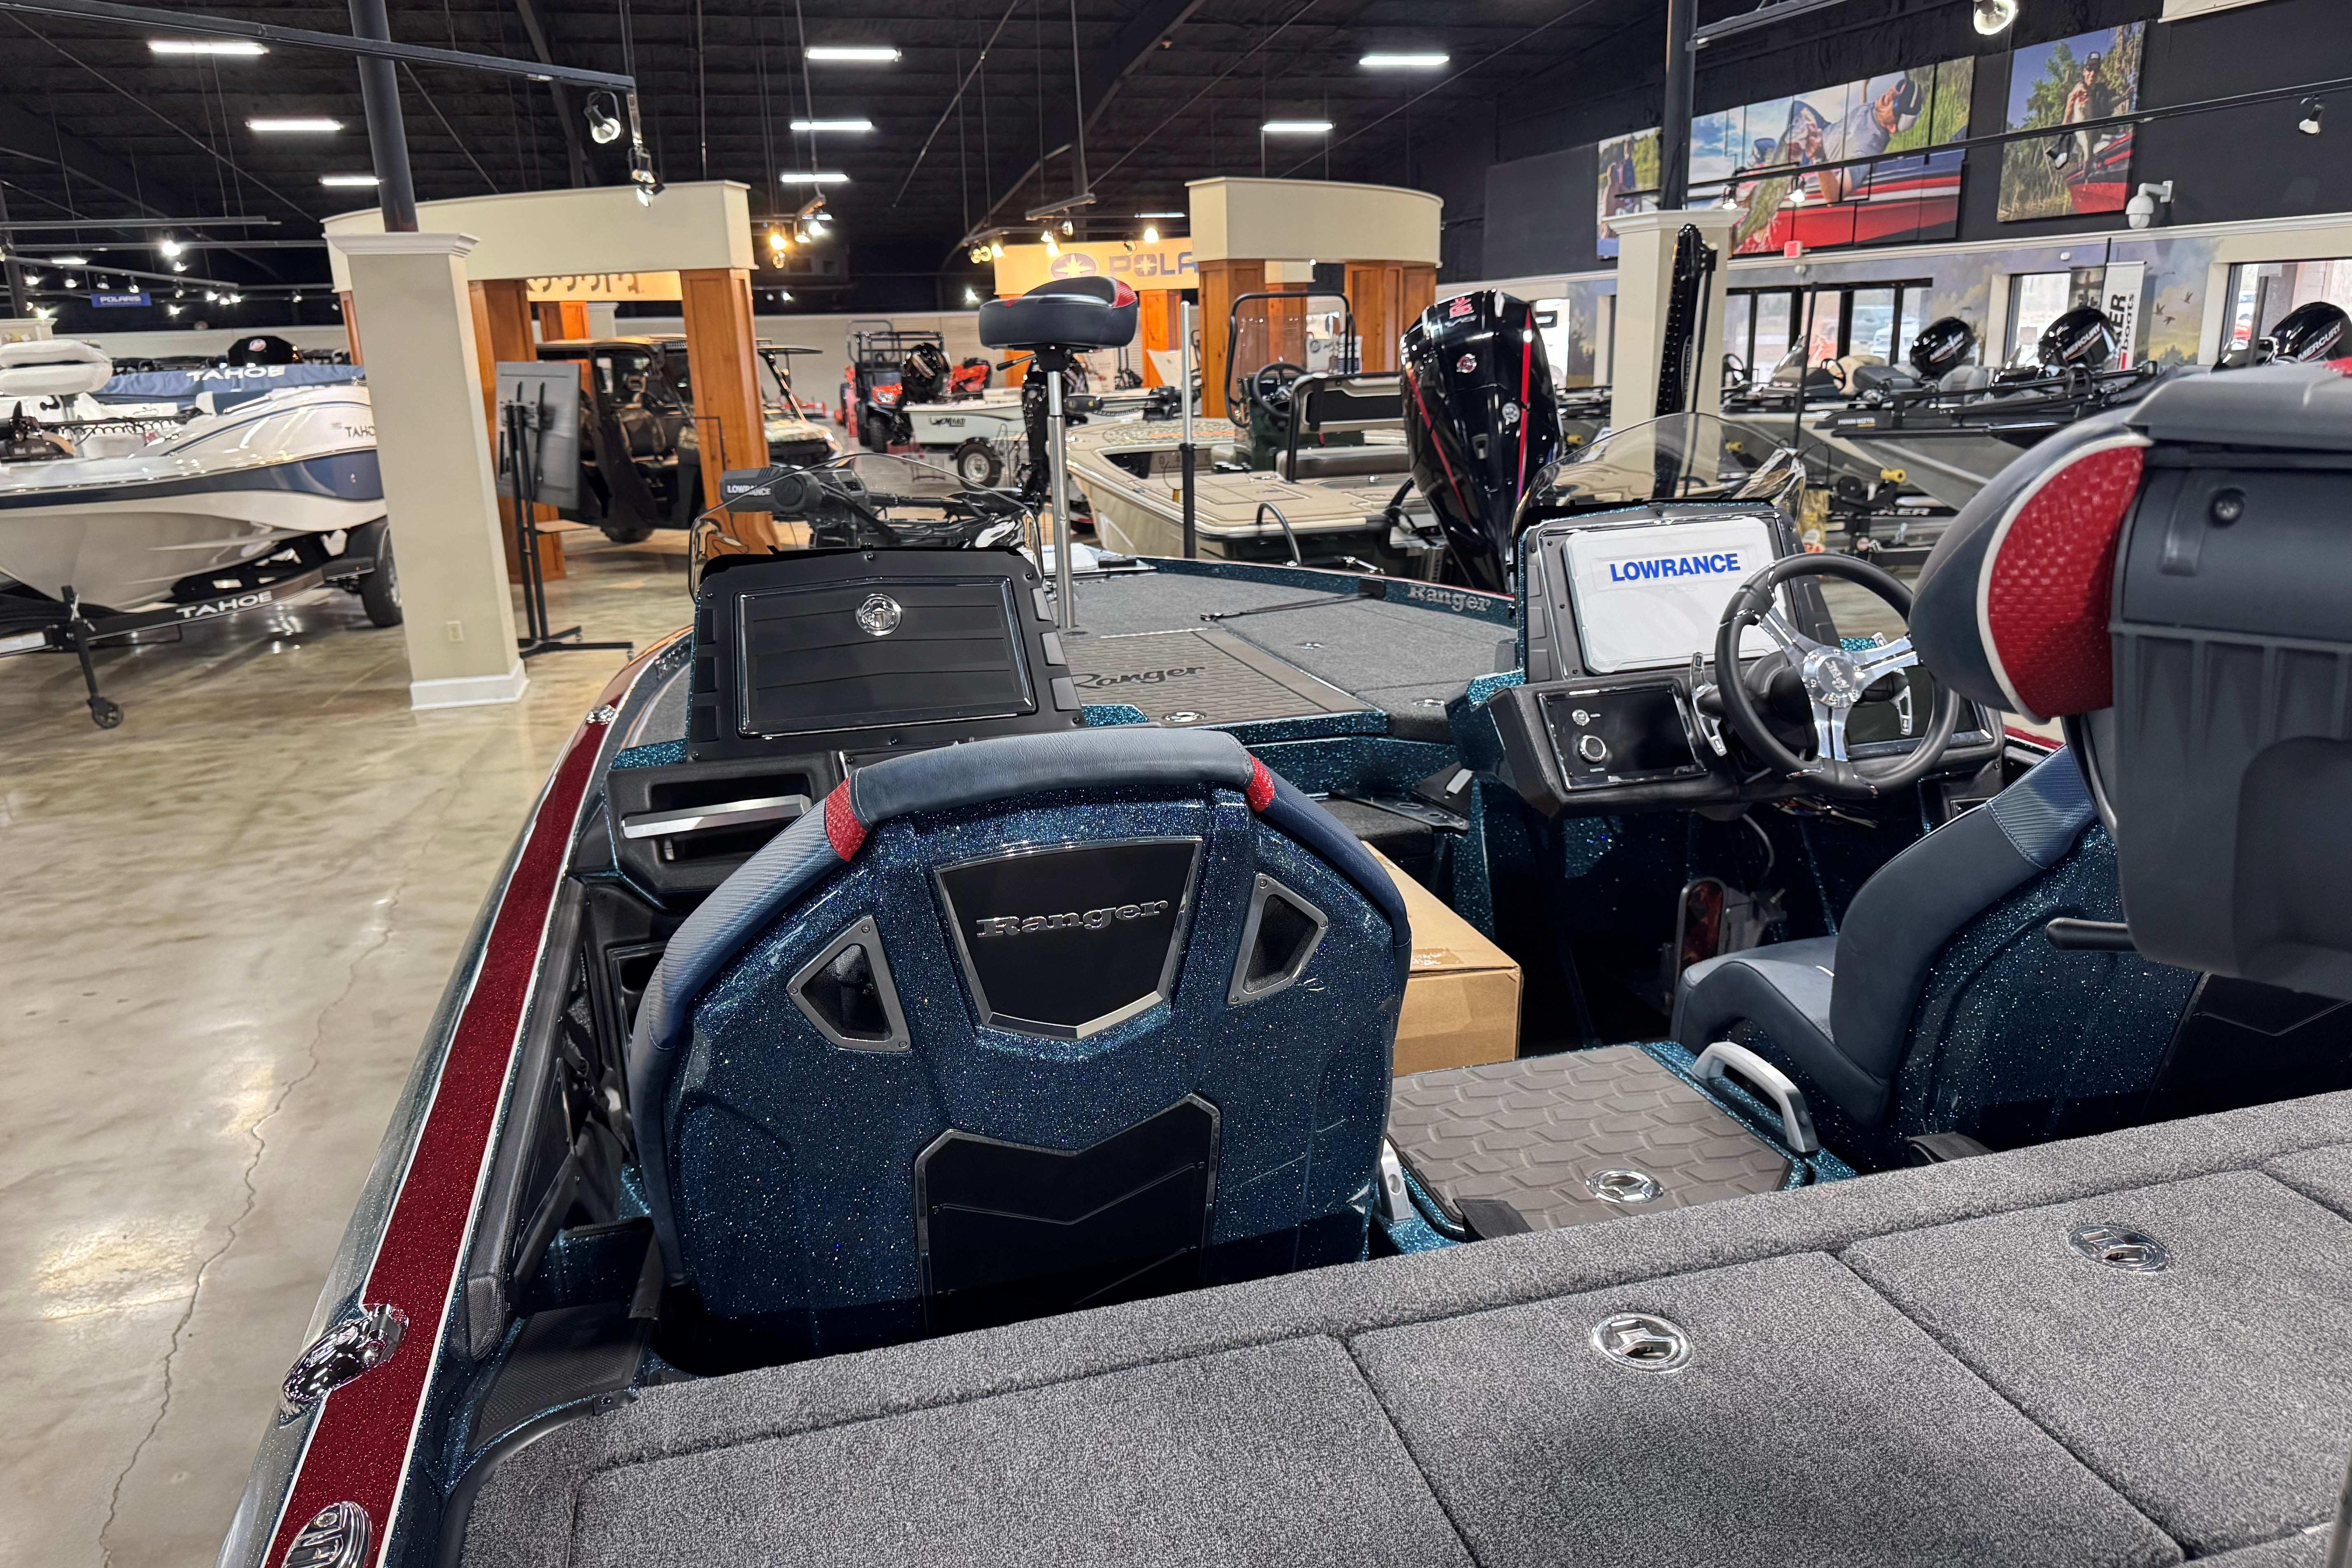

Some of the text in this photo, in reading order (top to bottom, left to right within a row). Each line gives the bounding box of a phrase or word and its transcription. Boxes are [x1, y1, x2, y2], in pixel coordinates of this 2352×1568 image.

[2063, 322, 2101, 360] MERCURY
[2298, 322, 2340, 362] MERCURY
[186, 365, 285, 382] TAHOE
[1610, 553, 1741, 582] LOWRANCE
[176, 590, 272, 618] TAHOE
[1407, 583, 1492, 612] Ranger
[977, 900, 1169, 938] Ranger
